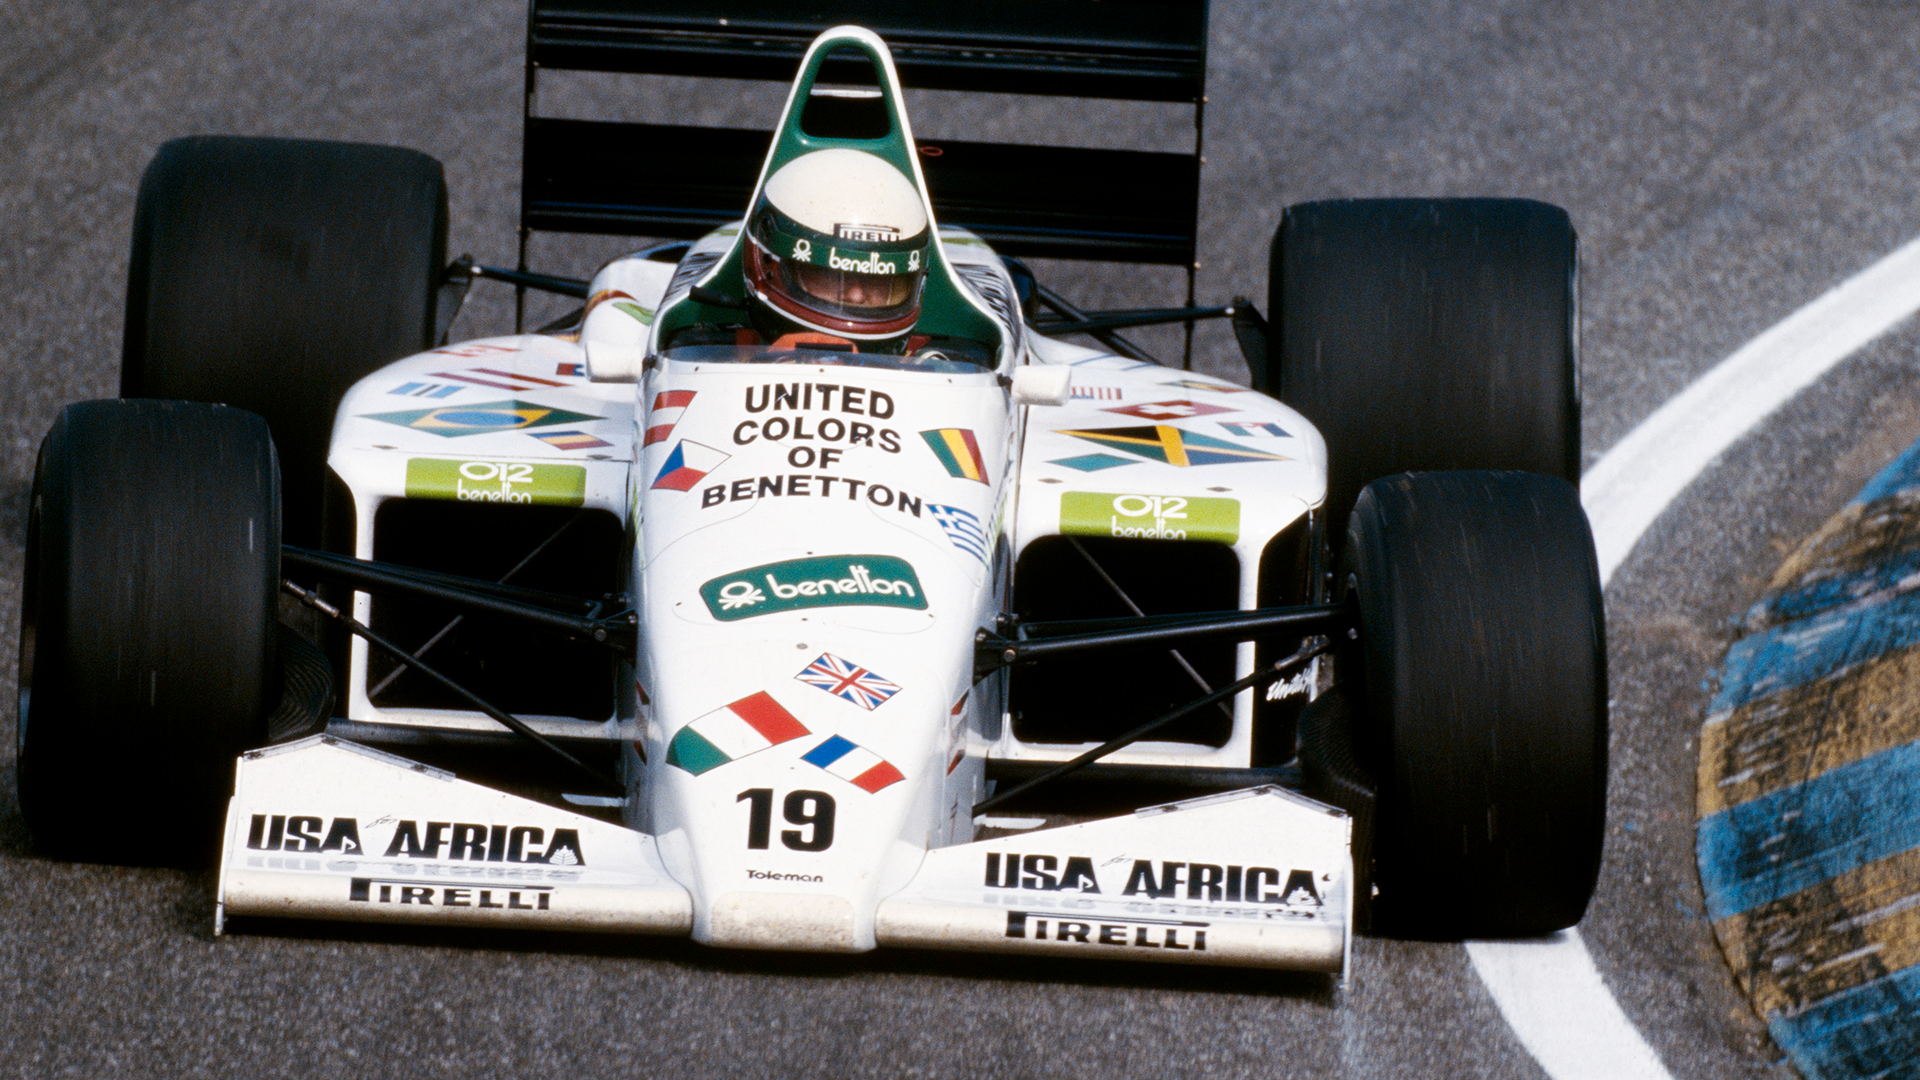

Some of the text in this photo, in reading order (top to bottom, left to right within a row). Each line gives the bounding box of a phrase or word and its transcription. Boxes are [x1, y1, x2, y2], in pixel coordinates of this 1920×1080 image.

[833, 223, 900, 241] PIRELLI
[829, 246, 896, 274] benetton
[745, 382, 895, 419] UNITED
[733, 416, 902, 454] COLORS
[787, 446, 844, 469] OF
[457, 479, 532, 504] benetton
[701, 474, 922, 518] BENETTON
[1111, 515, 1186, 540] benetton
[765, 565, 916, 598] benetton
[736, 787, 837, 853] 19
[246, 814, 364, 856] USA
[382, 819, 586, 866] AFRICA
[746, 869, 824, 883] Toleman
[984, 852, 1102, 895] USA
[1122, 859, 1323, 906] AFRICA
[349, 877, 555, 911] PIRELLI
[1005, 910, 1211, 951] PIRELLI
